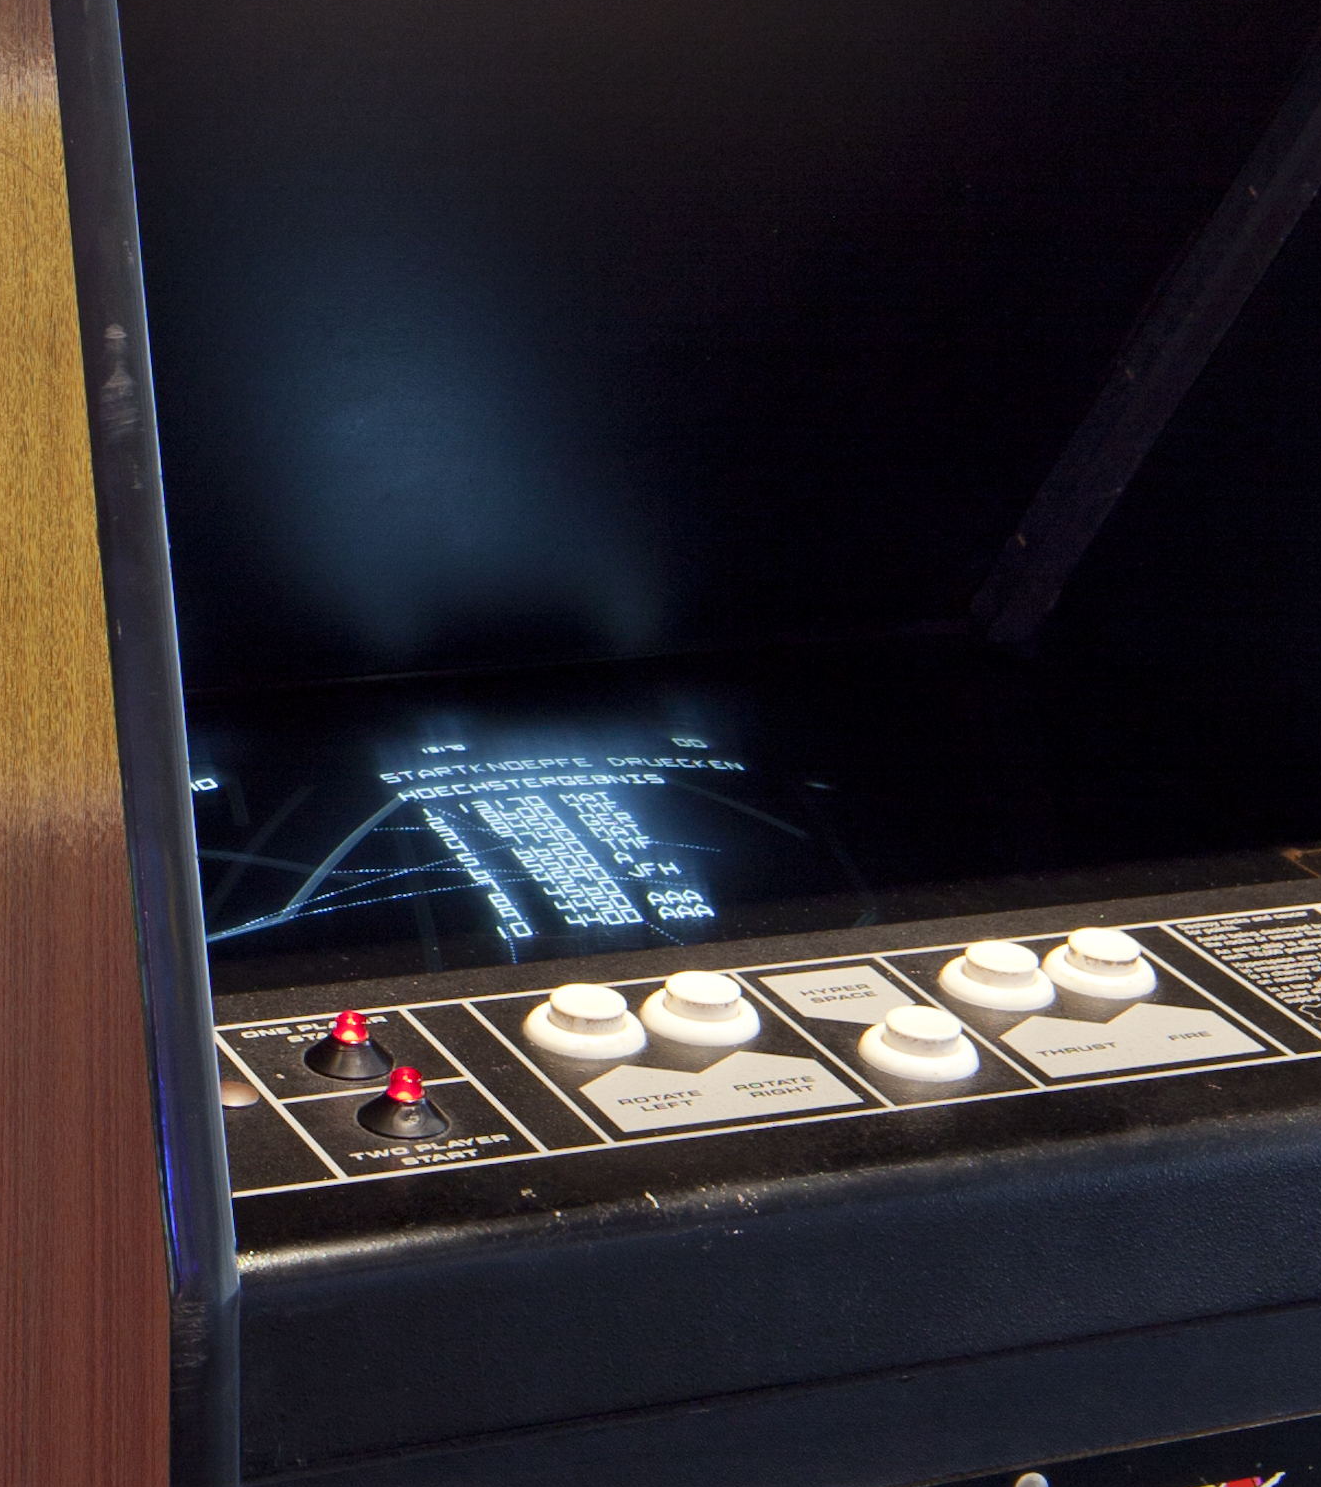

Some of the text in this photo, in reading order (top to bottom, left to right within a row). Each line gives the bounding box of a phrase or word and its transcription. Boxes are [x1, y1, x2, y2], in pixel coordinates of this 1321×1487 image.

[380, 756, 745, 784] STARTKNOEPFE DRUECKEN
[398, 772, 667, 802] HOECHSTERGEBNIS
[557, 791, 610, 802] MAT
[567, 801, 615, 813] TMF
[577, 811, 635, 826] GER
[588, 824, 642, 838] MAT
[599, 836, 648, 850] TMF
[615, 851, 635, 863] A
[627, 861, 682, 877] JFH
[647, 889, 706, 906] AAA
[659, 903, 716, 920] AAA
[799, 983, 872, 997] HYPER
[809, 991, 879, 1004] SPACE
[240, 1015, 388, 1039] ONE PLAR
[1167, 1030, 1213, 1042] FIRE
[1036, 1042, 1119, 1058] THRUST
[732, 1075, 816, 1092] ROTATE
[617, 1089, 703, 1106] ROTATE
[749, 1084, 815, 1099] RIGHT
[639, 1099, 694, 1113] LEFT
[349, 1133, 510, 1162] TWO PLAYER
[400, 1148, 479, 1166] START
